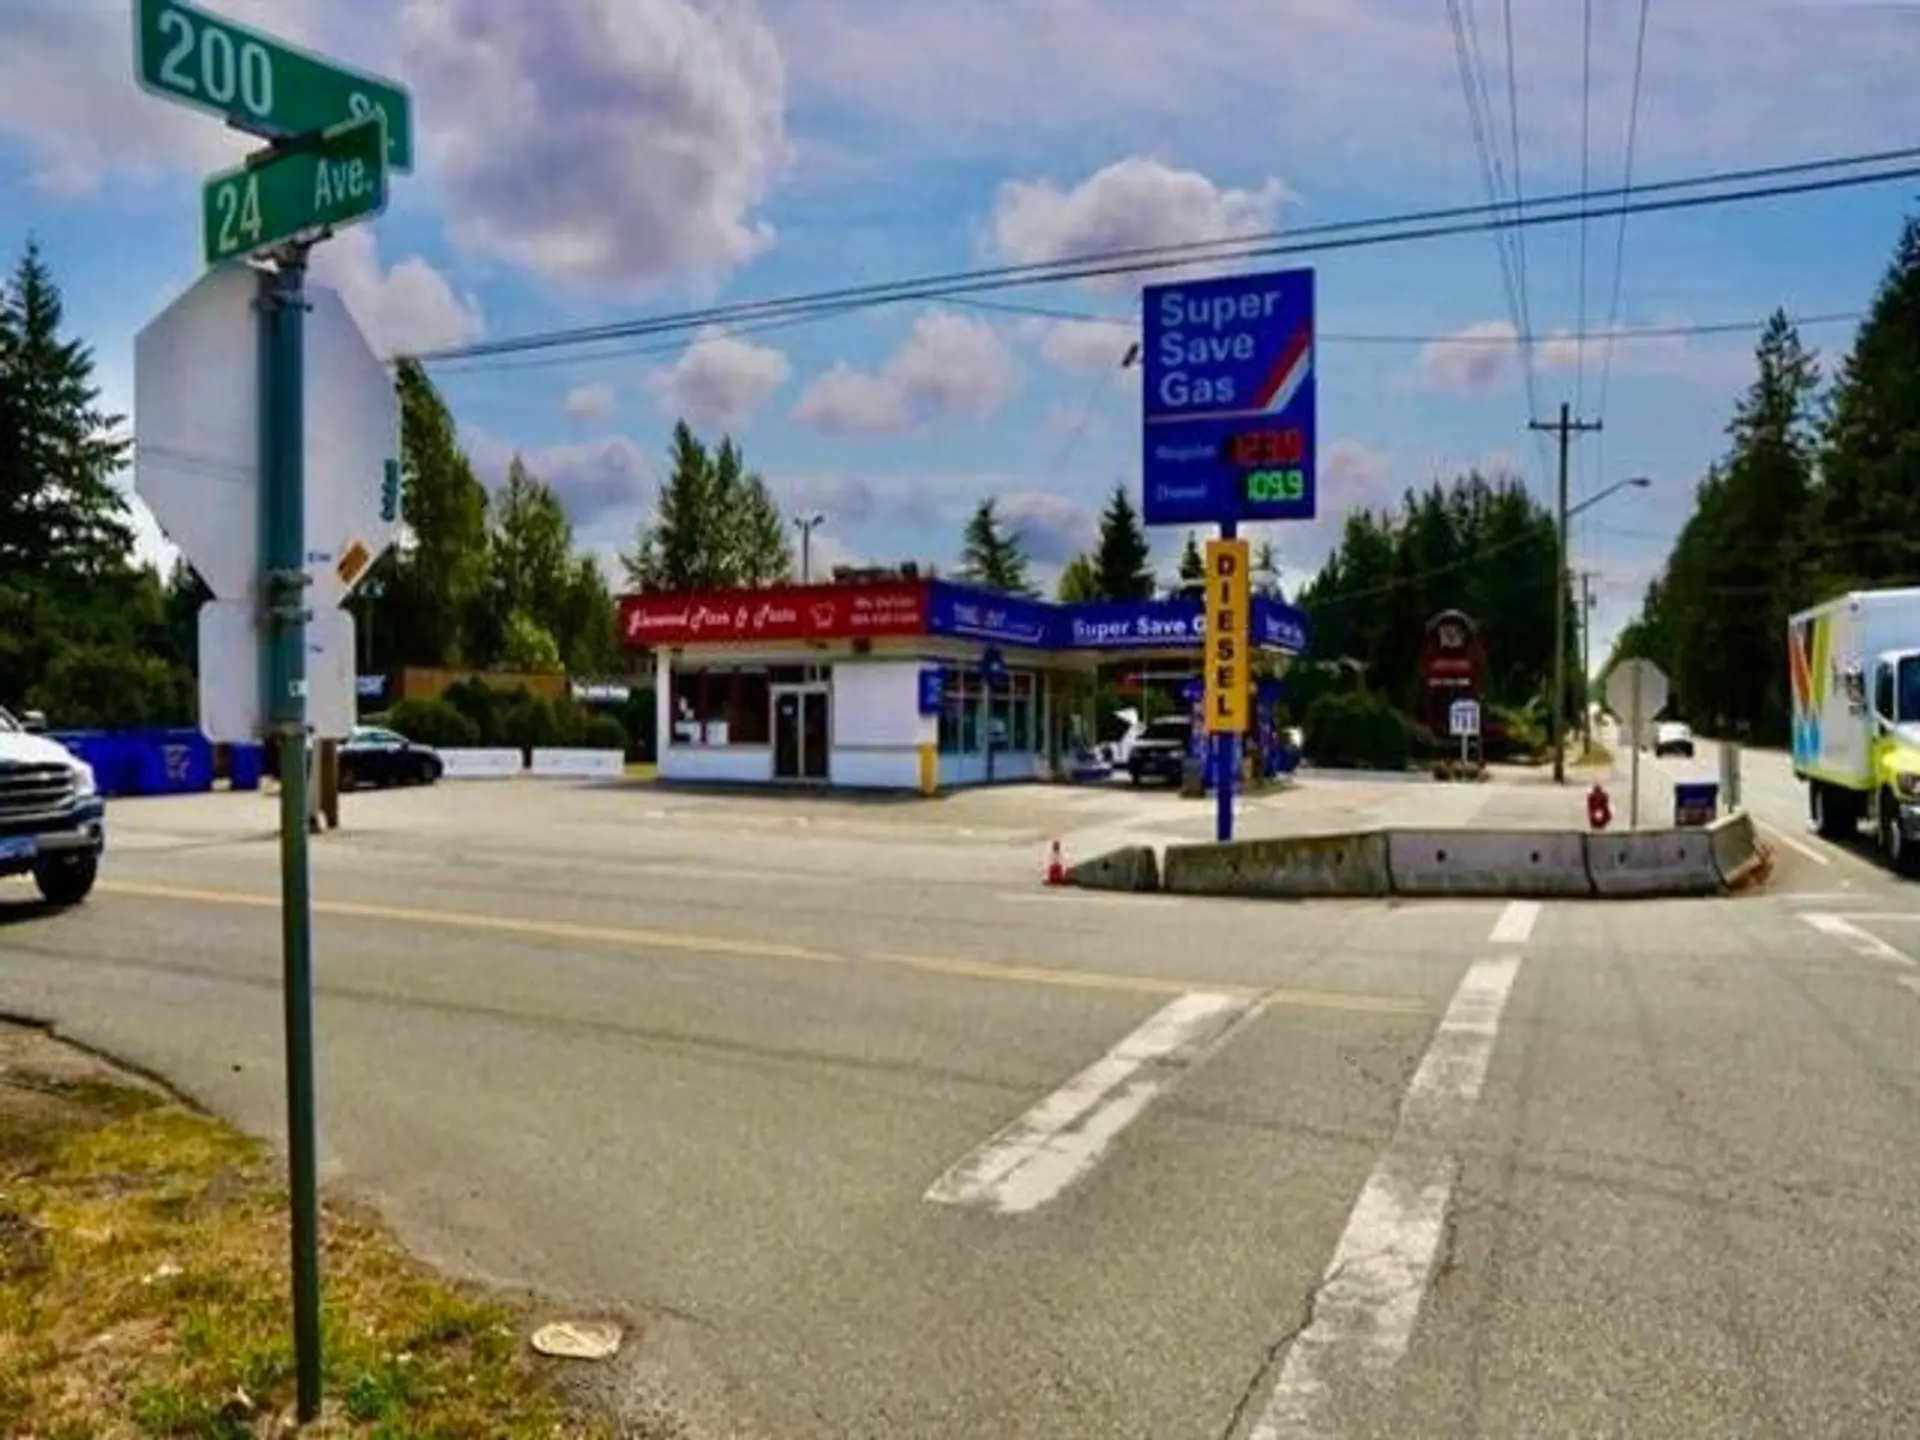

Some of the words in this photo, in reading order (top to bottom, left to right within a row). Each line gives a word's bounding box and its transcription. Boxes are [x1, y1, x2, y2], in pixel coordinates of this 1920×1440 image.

[157, 9, 273, 117] 200
[215, 173, 263, 253] 24
[313, 157, 374, 212] Ave.
[1159, 289, 1281, 331] Super
[1158, 332, 1256, 367] Save
[1157, 371, 1236, 406] Gas
[1072, 618, 1130, 643] Super
[1137, 615, 1187, 636] Save
[1216, 553, 1237, 717] DIESEL
